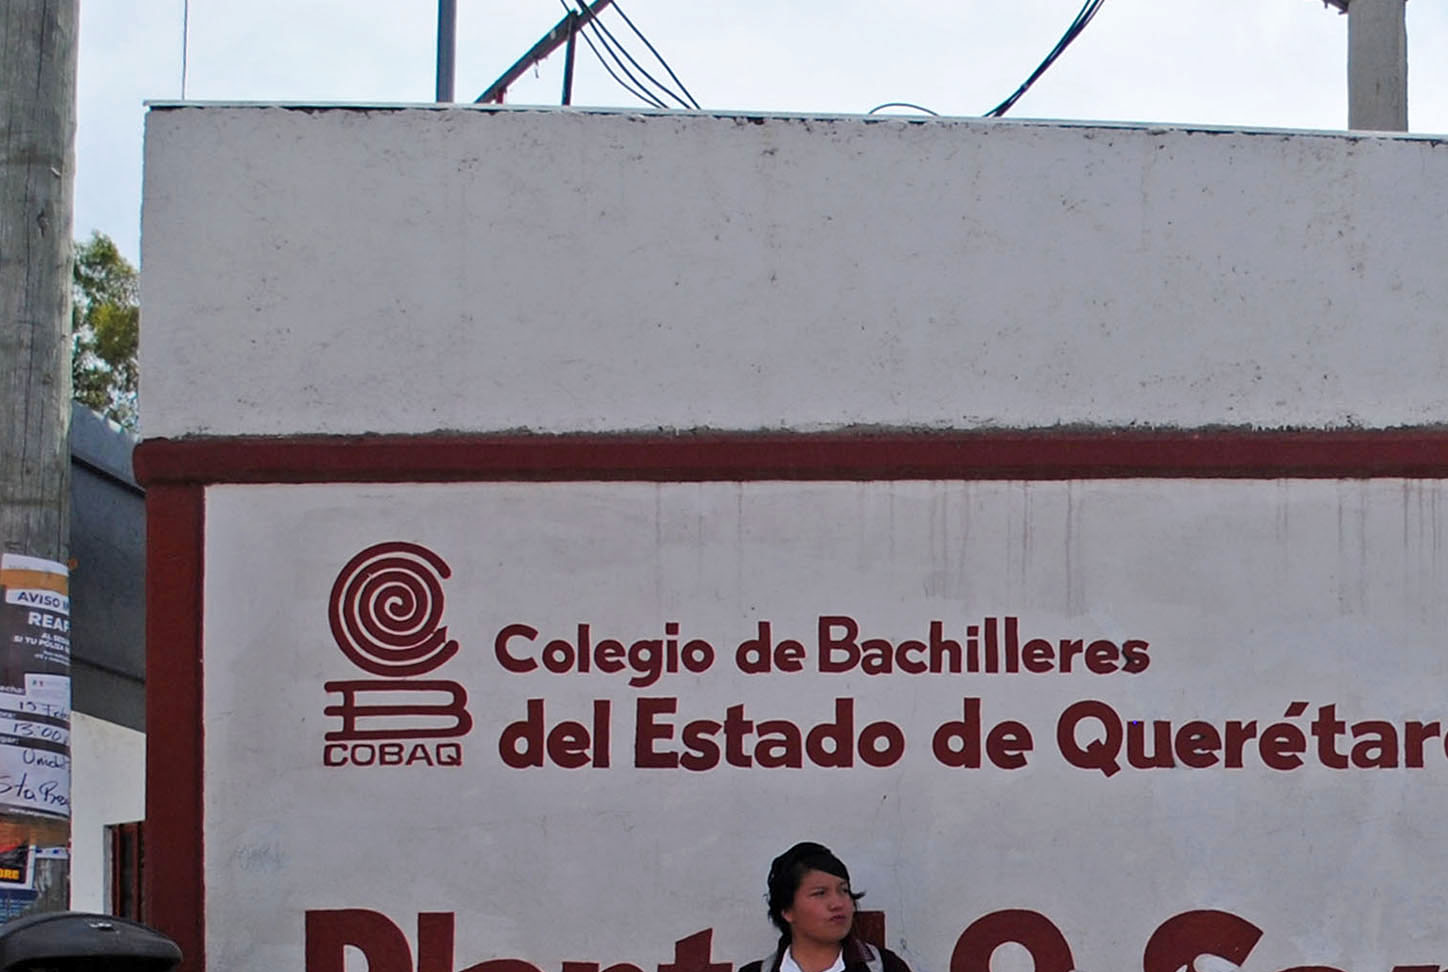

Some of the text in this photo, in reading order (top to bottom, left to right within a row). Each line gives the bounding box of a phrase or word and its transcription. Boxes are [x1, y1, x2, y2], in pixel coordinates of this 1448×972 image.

[17, 591, 60, 609] AVISO
[494, 615, 1151, 688] Colegio de Bachilleres
[323, 742, 462, 768] COBAQ
[498, 698, 611, 769] del
[633, 697, 905, 772] Estado
[931, 697, 1034, 770] de
